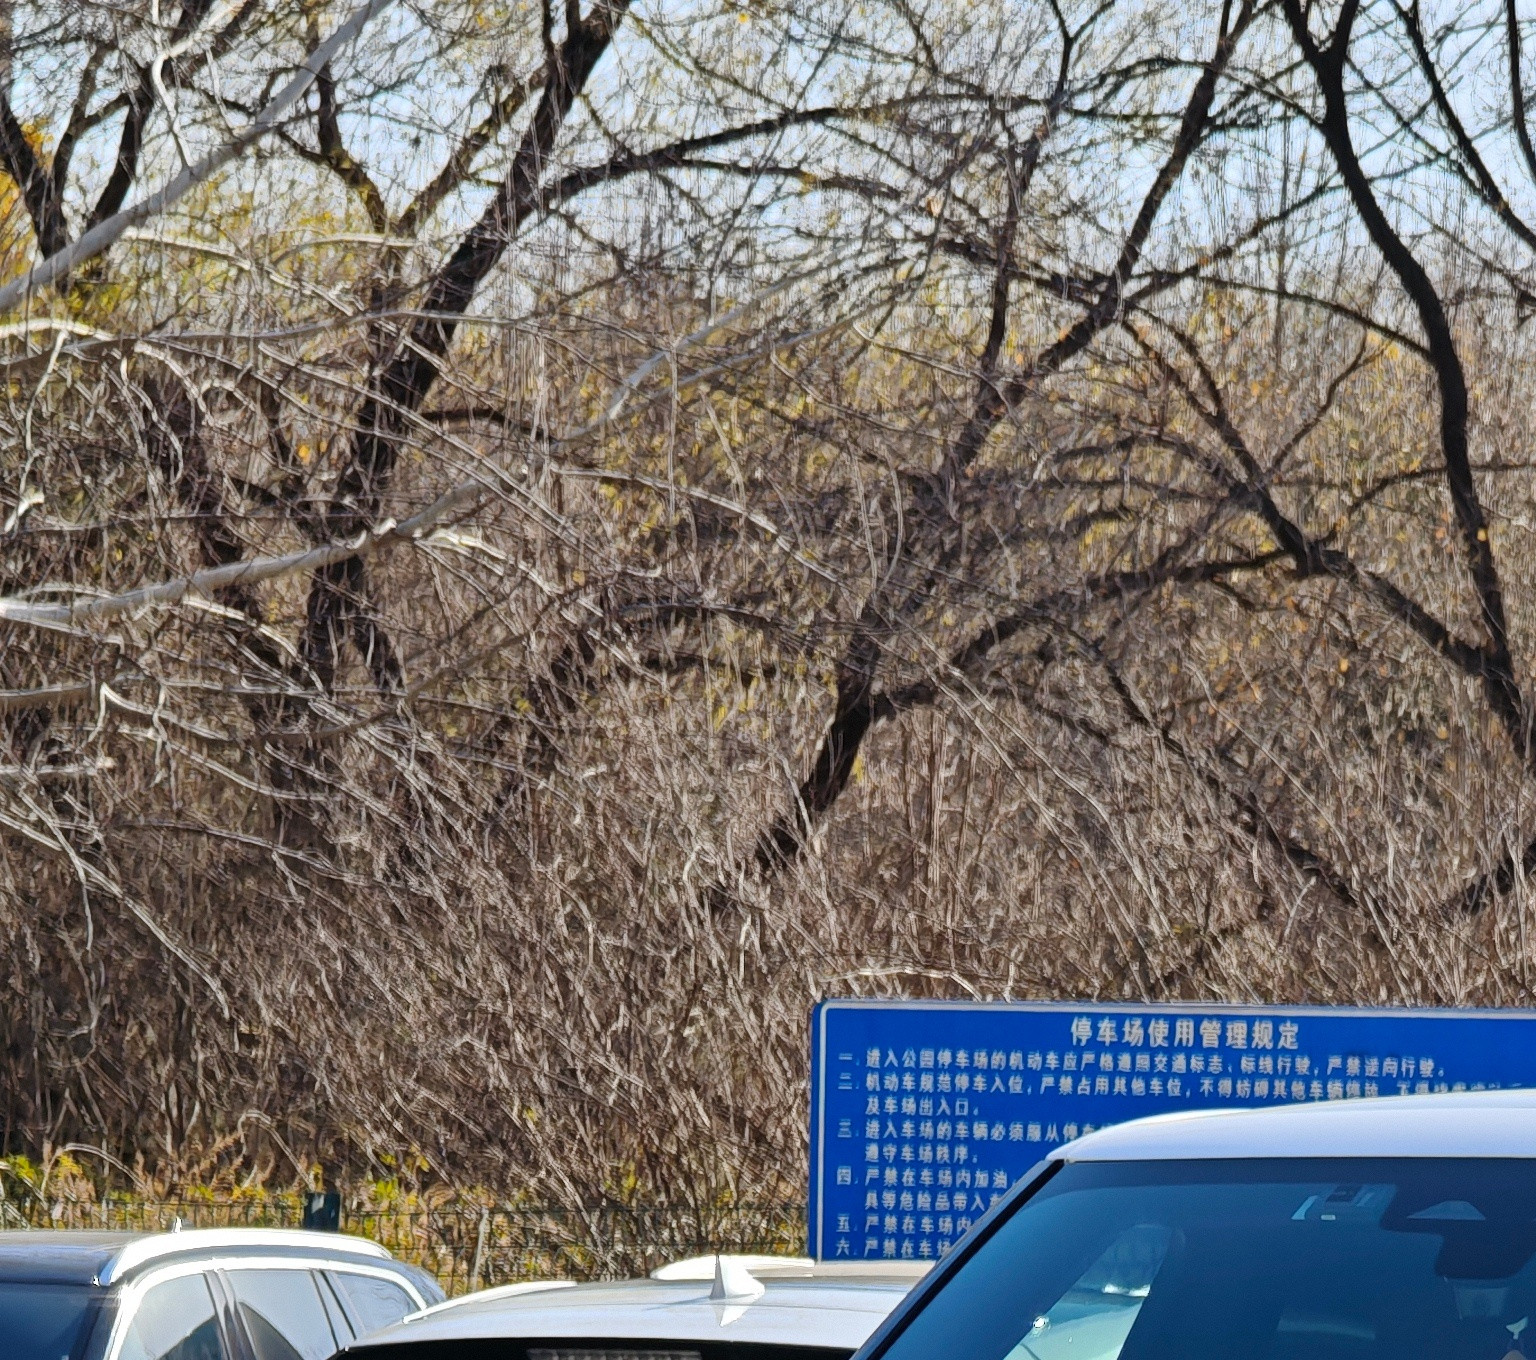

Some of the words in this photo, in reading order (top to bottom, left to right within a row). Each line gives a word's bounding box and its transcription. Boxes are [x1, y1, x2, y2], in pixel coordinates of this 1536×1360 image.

[1071, 1015, 1300, 1051] 停车场使用管理规定
